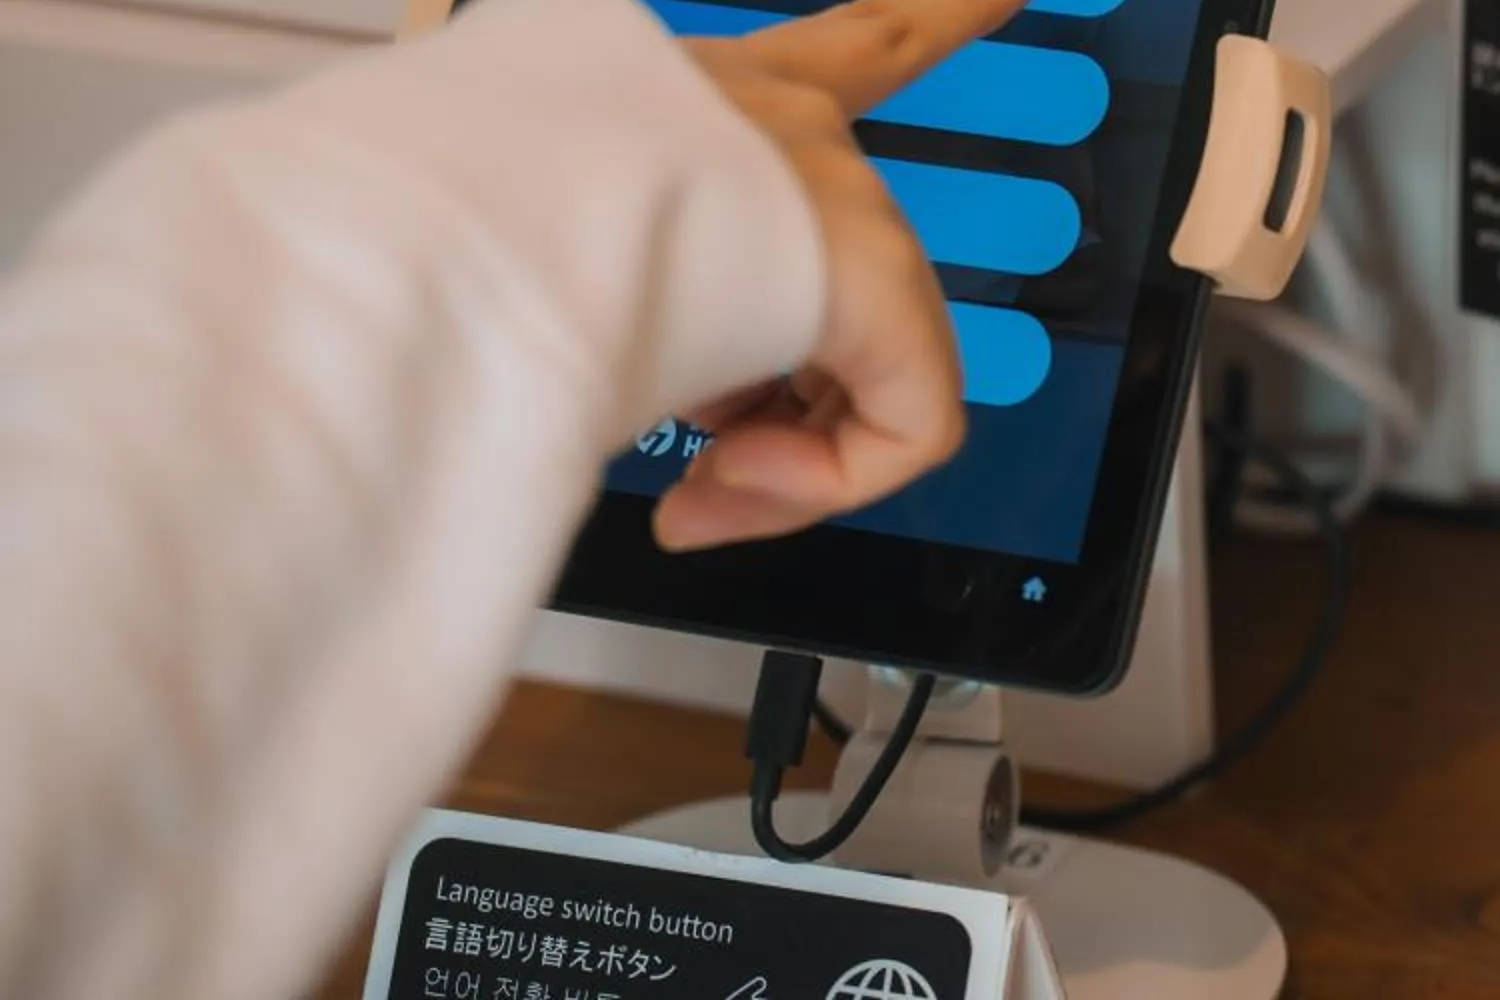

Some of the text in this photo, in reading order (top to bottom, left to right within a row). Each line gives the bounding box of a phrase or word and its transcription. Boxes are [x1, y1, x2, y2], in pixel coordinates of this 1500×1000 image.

[436, 876, 734, 943] Language switch button
[425, 917, 677, 981] 言語切り替えボタン
[425, 967, 481, 1000] 언어
